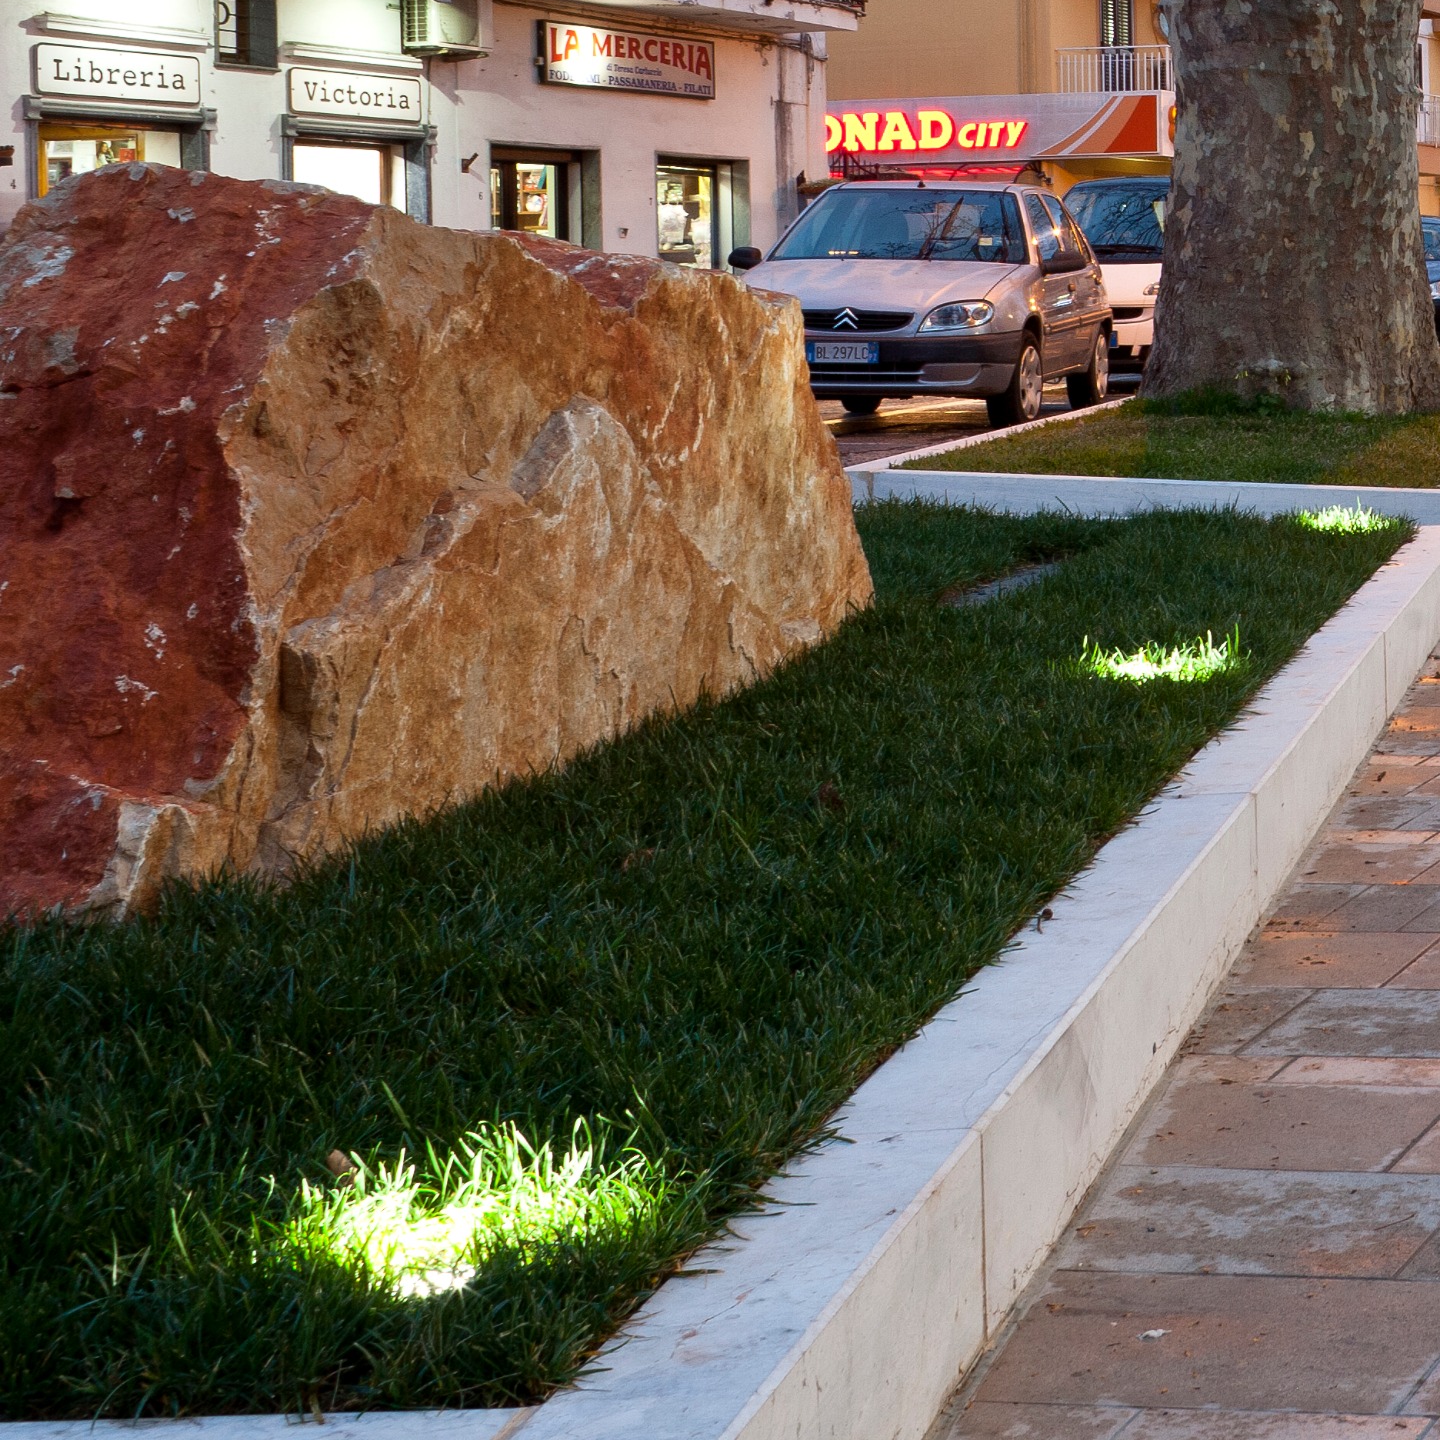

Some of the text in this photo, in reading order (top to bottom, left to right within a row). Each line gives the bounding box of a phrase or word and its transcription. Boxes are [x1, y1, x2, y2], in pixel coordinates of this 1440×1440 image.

[550, 27, 712, 81] LA MERCERIA
[53, 58, 186, 90] Libreria
[608, 75, 677, 92] PASSAMANERIA
[684, 83, 712, 95] FILATI
[304, 80, 411, 110] Victoria
[958, 121, 1028, 148] CITY
[10, 179, 16, 189] 4
[816, 346, 830, 359] BL
[832, 346, 869, 360] 297LC
